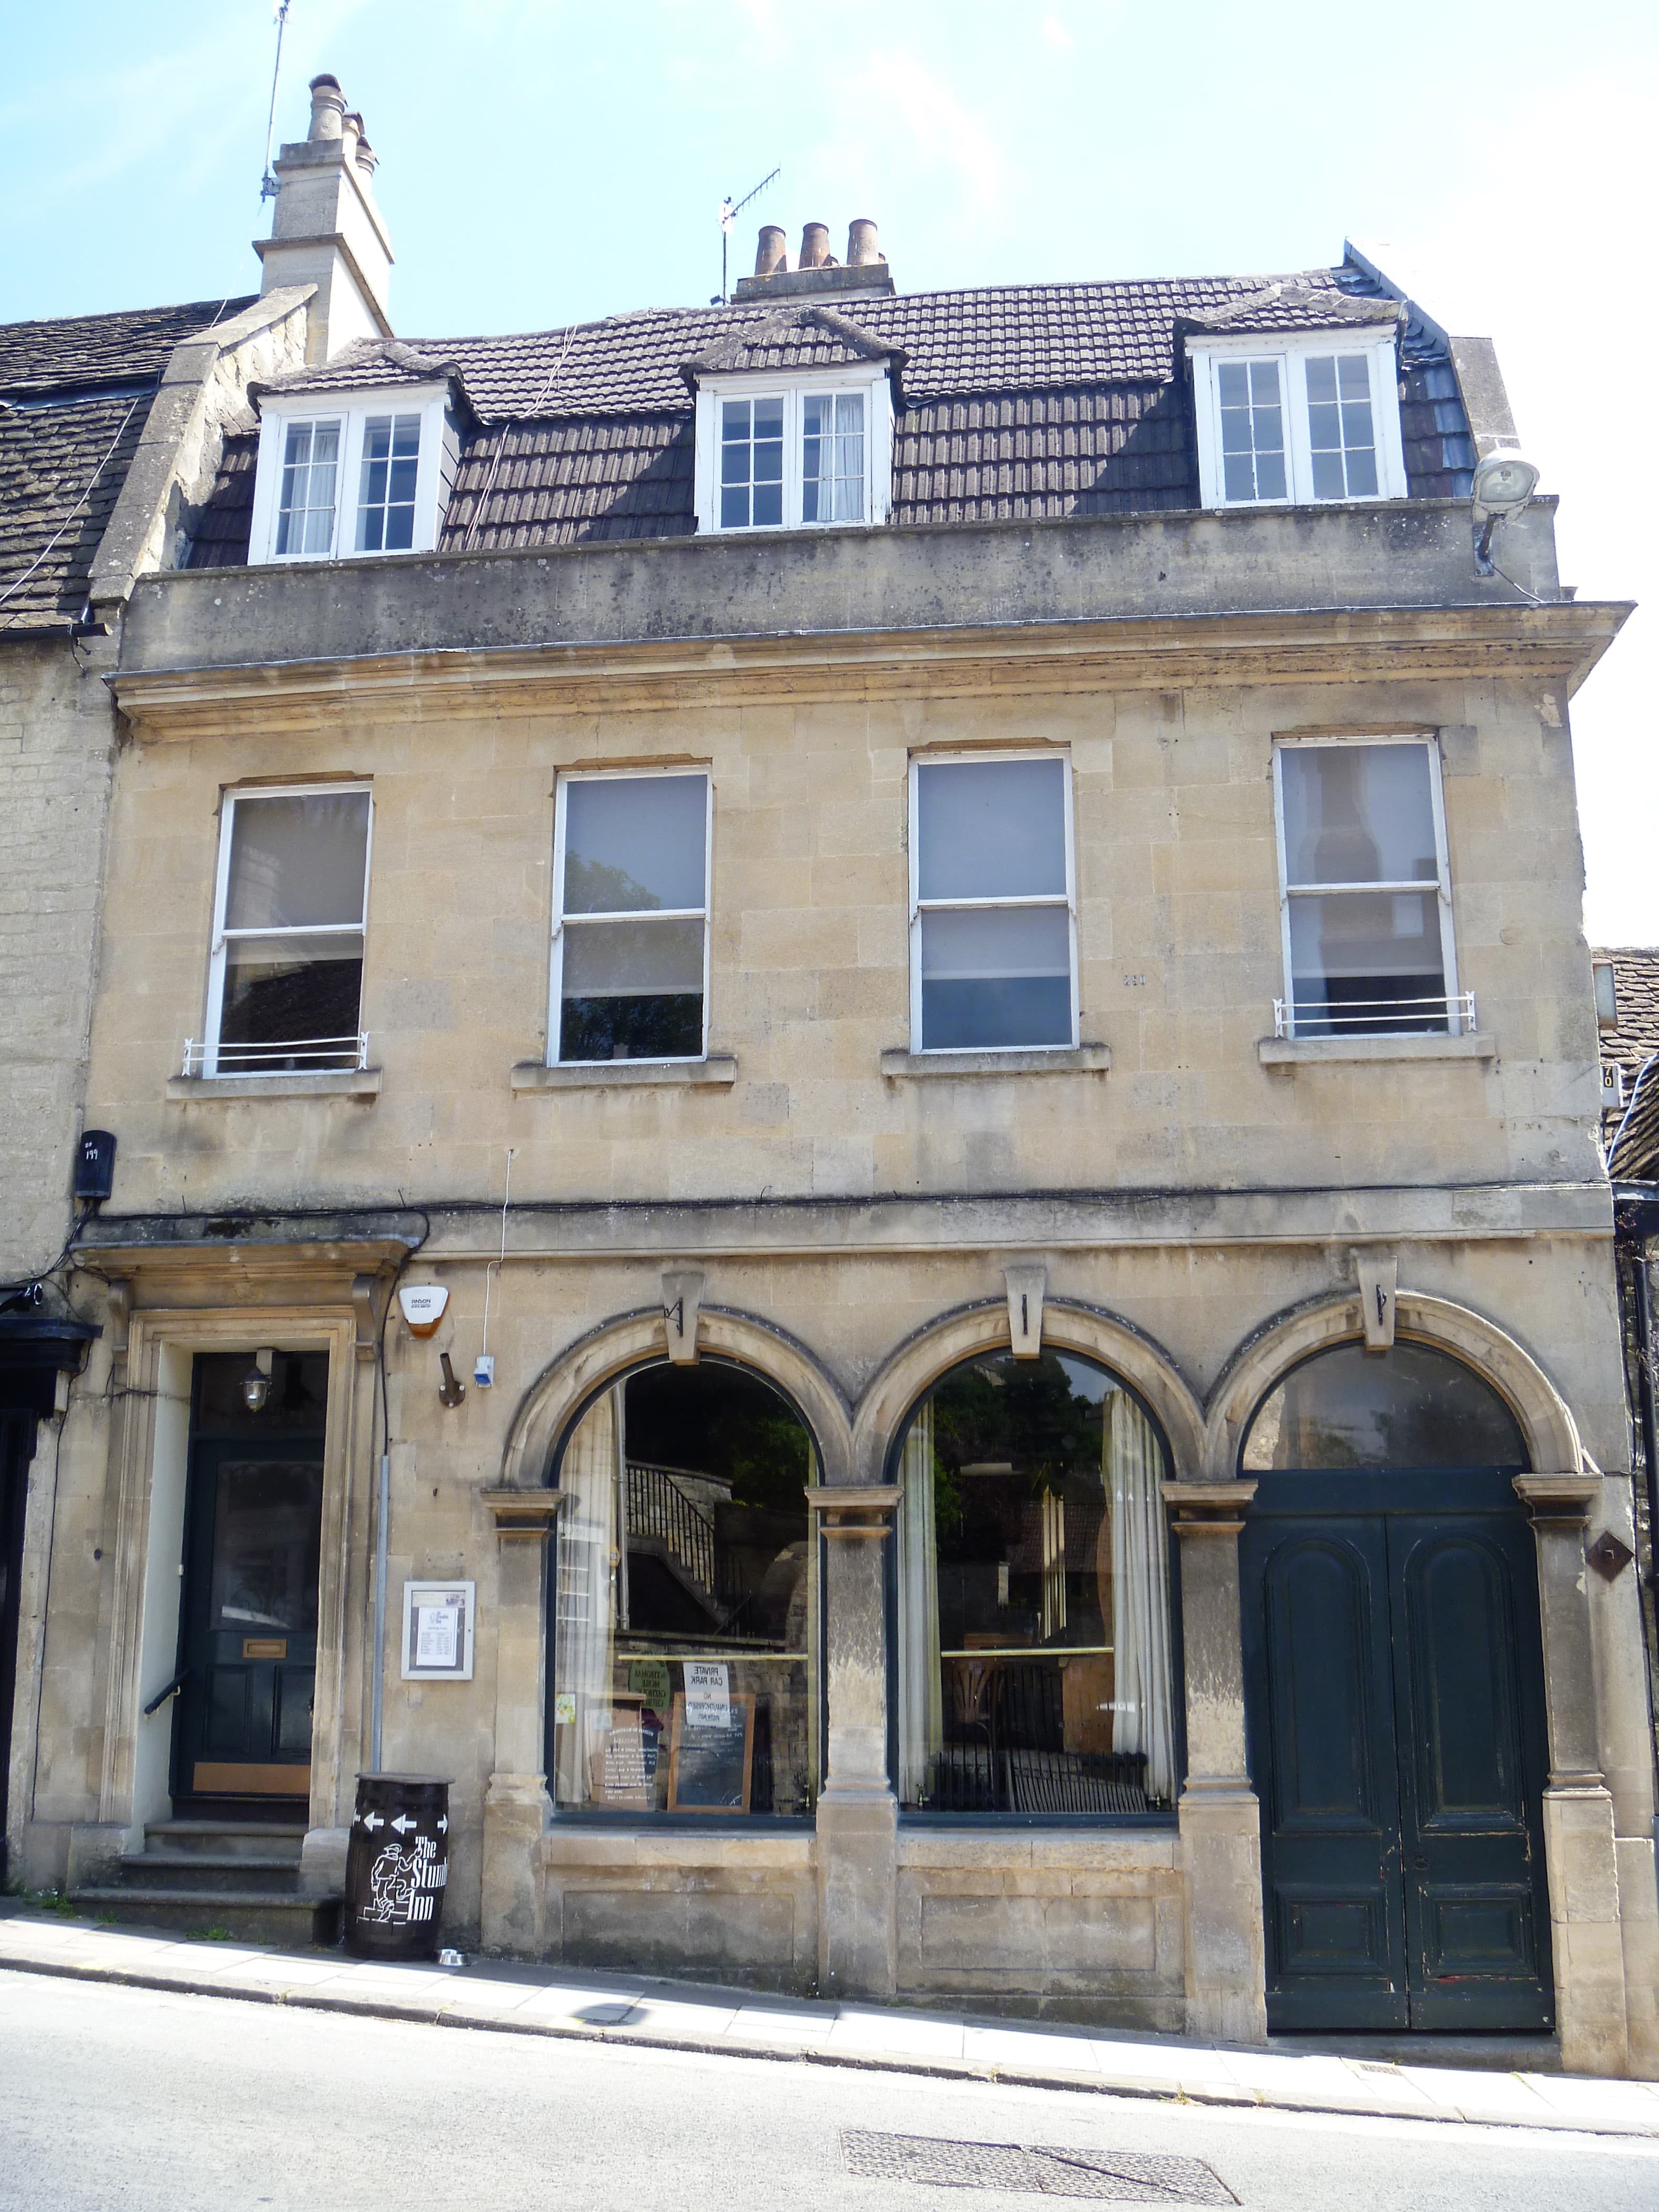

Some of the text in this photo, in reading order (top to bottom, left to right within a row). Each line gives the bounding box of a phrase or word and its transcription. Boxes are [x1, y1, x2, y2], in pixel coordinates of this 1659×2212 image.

[1604, 1066, 1612, 1087] 70
[86, 1149, 98, 1160] 199
[415, 1836, 437, 1859] The
[407, 1888, 434, 1921] Inn
